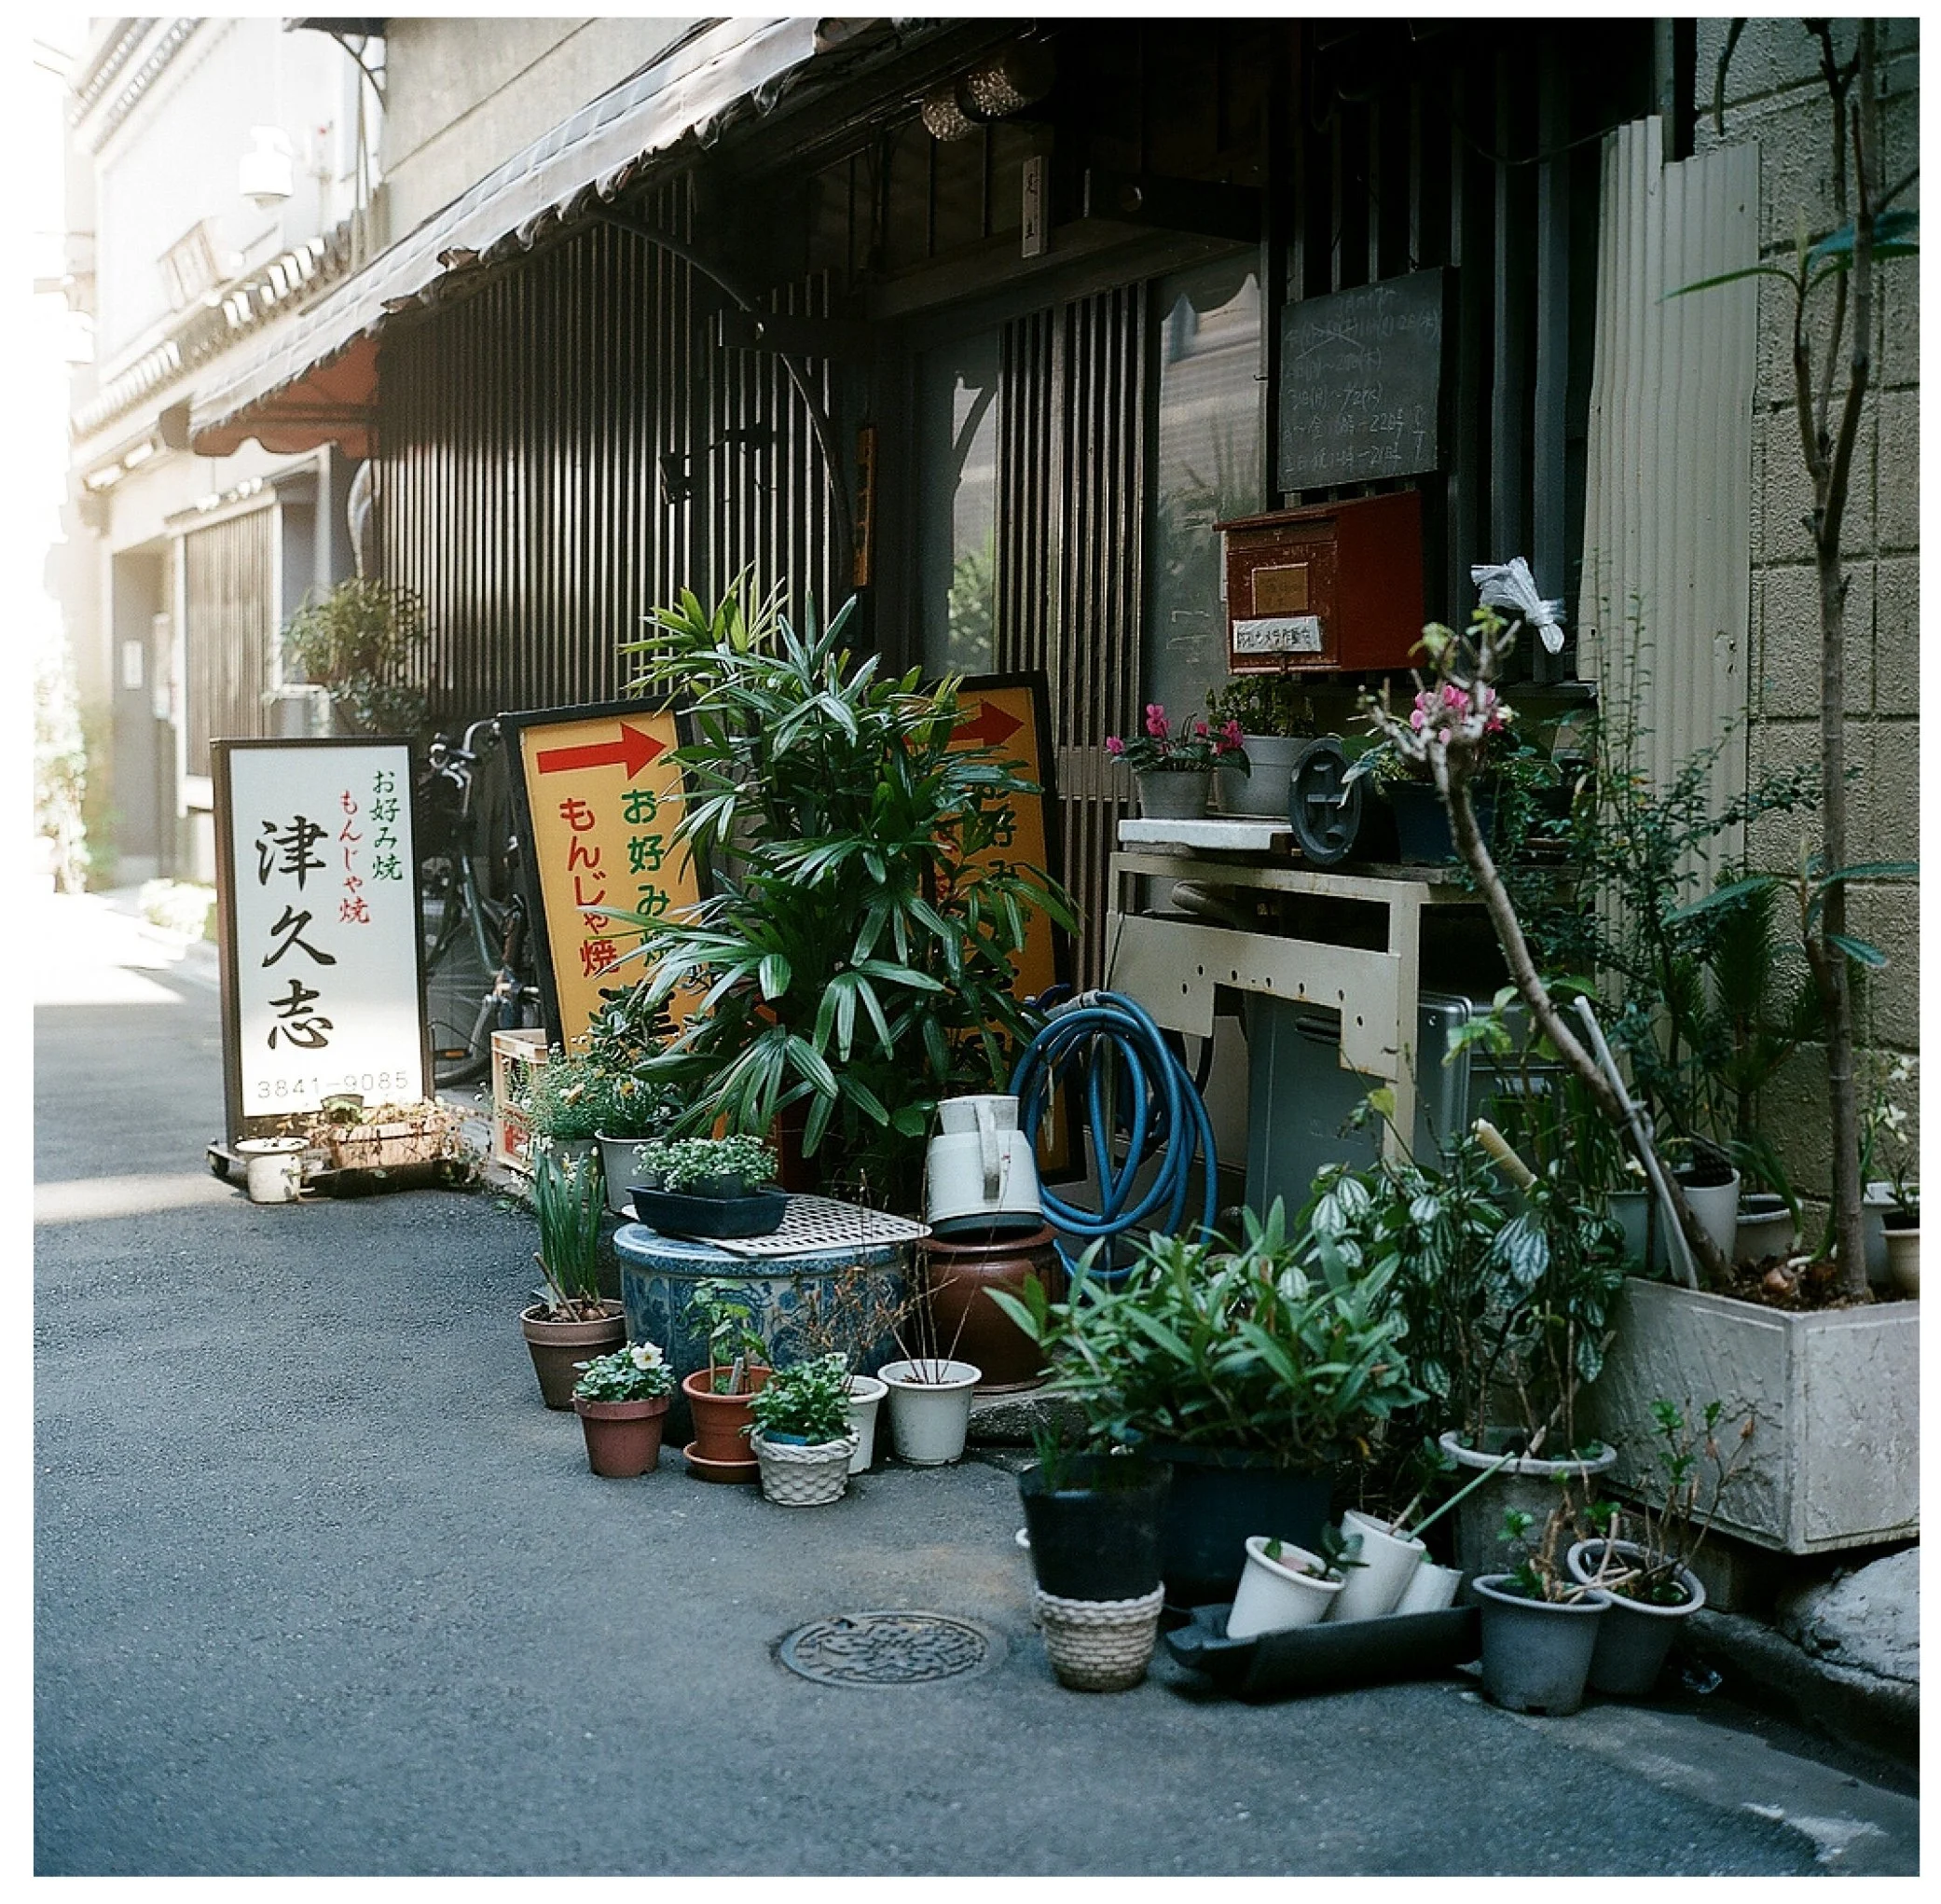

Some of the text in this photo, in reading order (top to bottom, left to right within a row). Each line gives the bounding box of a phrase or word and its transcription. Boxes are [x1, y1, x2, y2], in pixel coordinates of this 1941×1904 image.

[339, 790, 370, 924] もんじゃ焼
[369, 770, 403, 880] お好み焼
[559, 797, 620, 977] もんじゃ焼
[255, 815, 337, 1050] 津久志
[257, 1071, 408, 1098] 3841-9085
